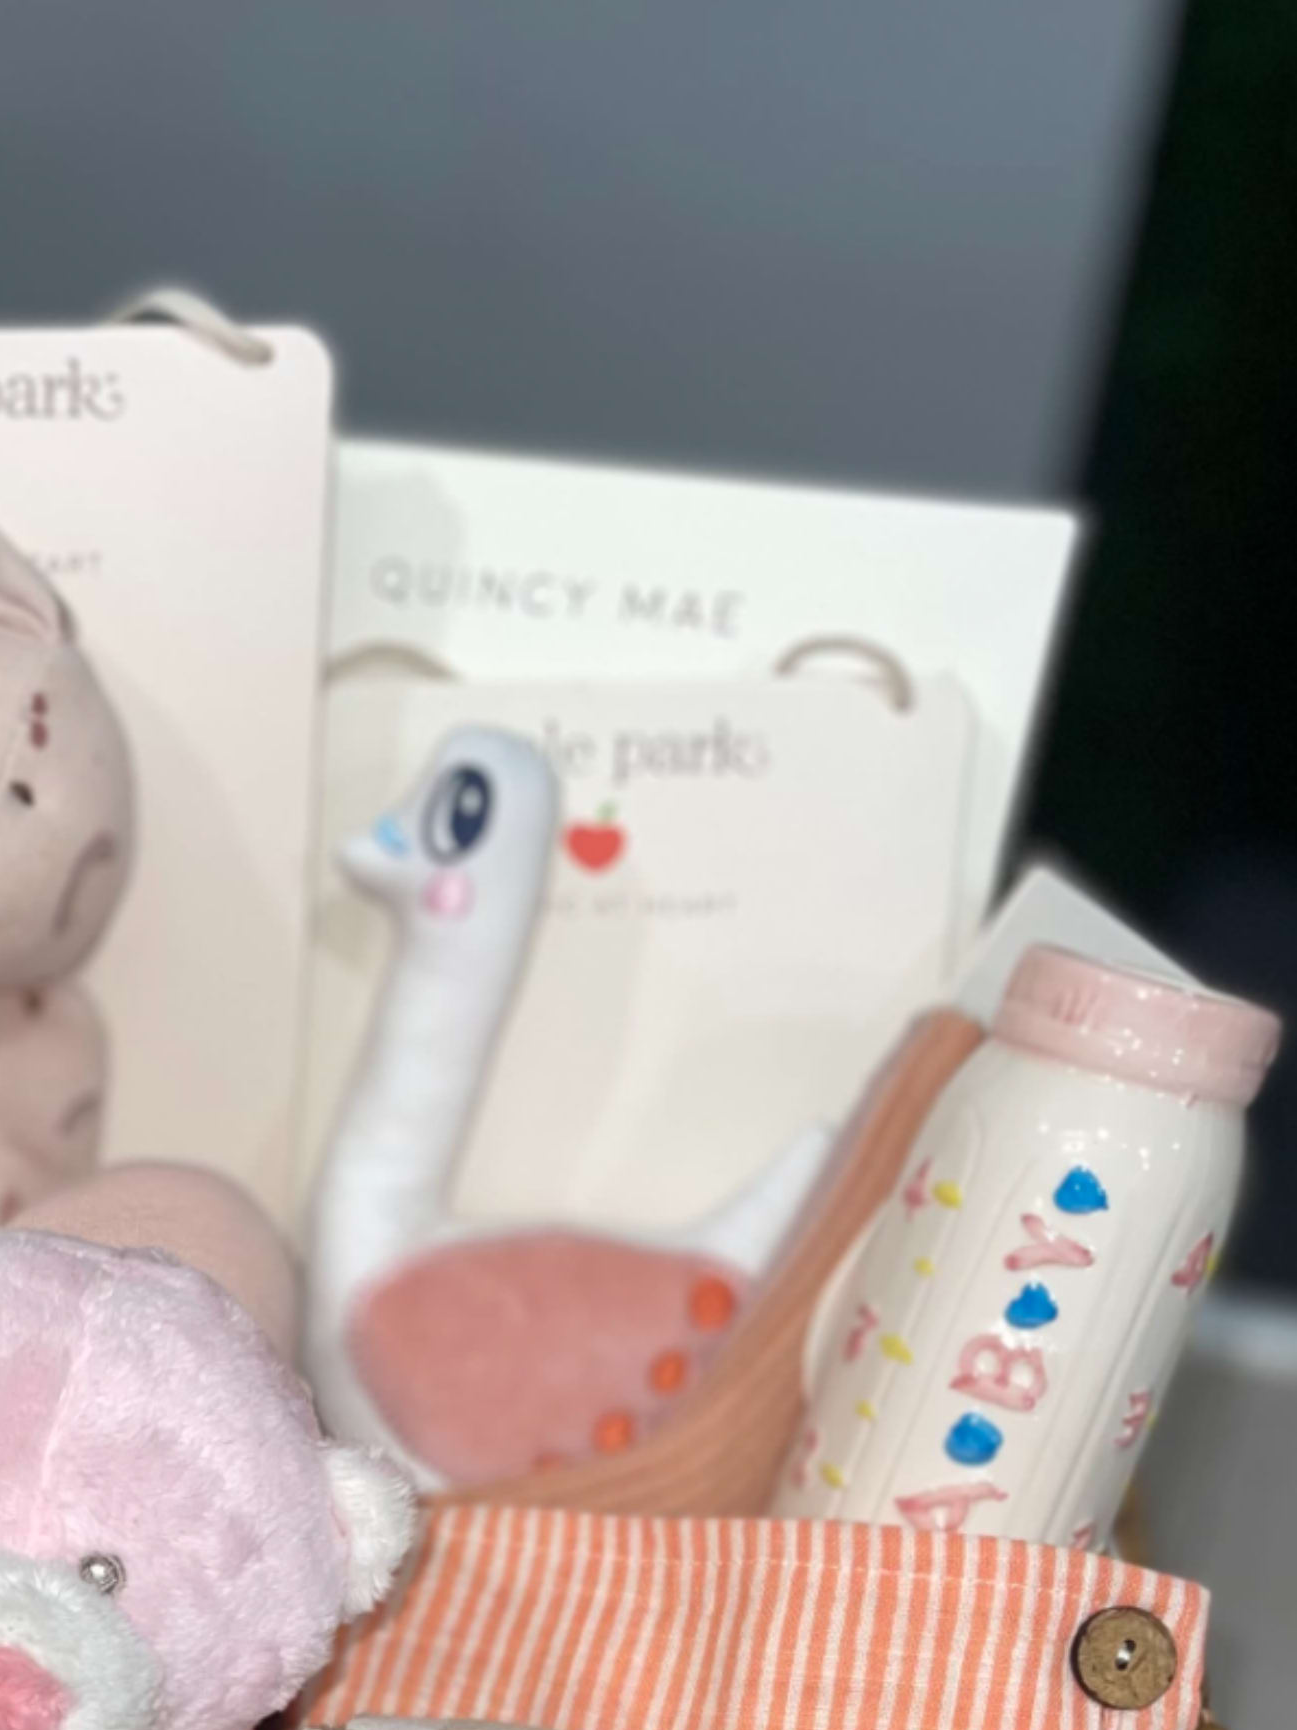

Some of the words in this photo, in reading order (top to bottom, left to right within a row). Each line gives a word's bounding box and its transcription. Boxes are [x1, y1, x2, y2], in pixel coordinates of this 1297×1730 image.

[367, 553, 600, 620] QUINCY
[616, 579, 746, 639] MAE
[612, 713, 771, 789] park
